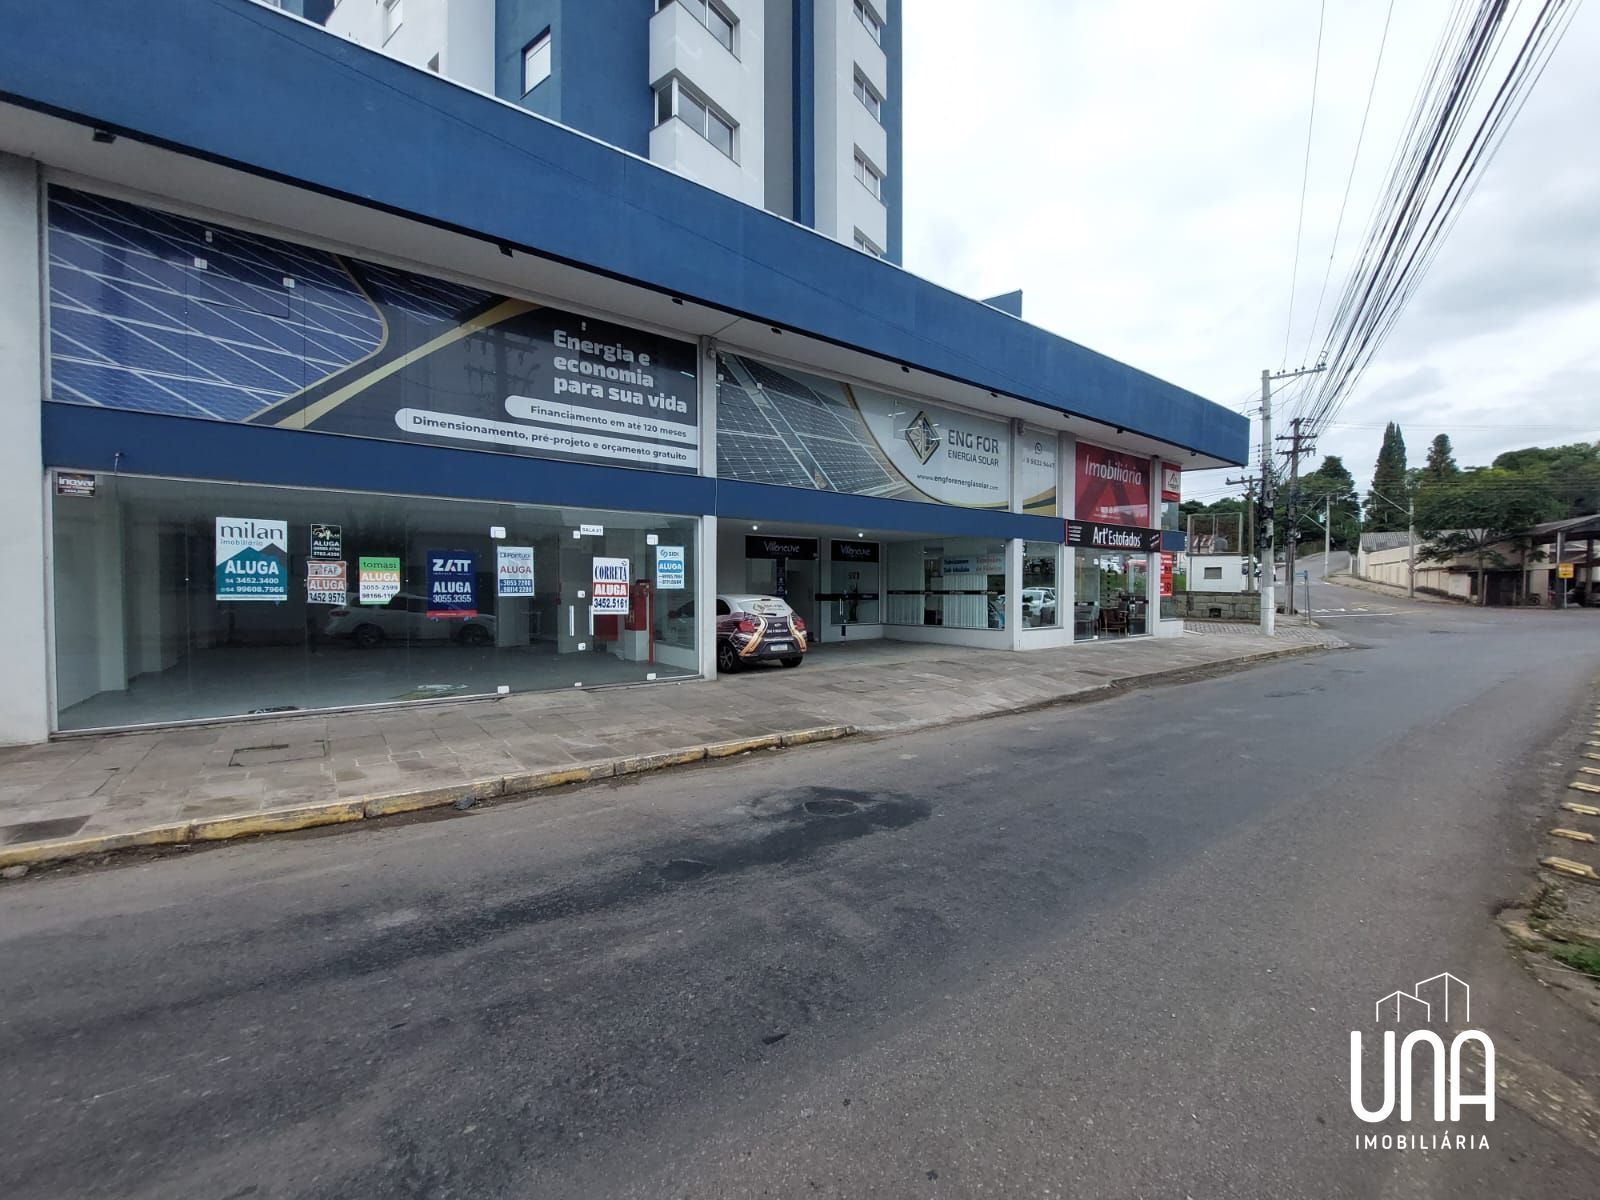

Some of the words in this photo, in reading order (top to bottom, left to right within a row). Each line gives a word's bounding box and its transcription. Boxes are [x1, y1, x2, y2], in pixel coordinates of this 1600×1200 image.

[553, 329, 635, 363] Energia
[638, 353, 651, 366] e
[553, 356, 654, 388] economia
[553, 377, 604, 399] para
[608, 387, 644, 405] sua
[648, 393, 688, 413] vida
[530, 405, 607, 425] Financiamento
[610, 419, 625, 428] em
[627, 420, 642, 431] até
[643, 423, 658, 433] 120
[660, 428, 687, 438] meses
[413, 415, 529, 440] Dimensionamento,
[531, 431, 591, 449] pré-projeto
[601, 443, 651, 456] orçamento
[652, 449, 687, 461] gratuito
[948, 429, 973, 449] ENG
[976, 435, 999, 454] FOR
[948, 449, 977, 463] ENERGIA
[978, 456, 999, 467] SOLAR
[1085, 454, 1142, 485] Imobiliária
[59, 476, 94, 487] inovar
[917, 474, 999, 491] www.engforenergiasolar.com
[220, 521, 283, 540] milan
[224, 560, 279, 575] ALUGA
[323, 564, 338, 573] FAF
[363, 561, 397, 569] tomasi
[432, 559, 472, 572] ZATT
[500, 565, 532, 574] ALUGA
[659, 562, 682, 570] ALUGA
[361, 572, 398, 581] ALUGA
[594, 565, 627, 581] CORRETA
[309, 580, 345, 590] ALUGA
[433, 581, 472, 593] ALUGA
[594, 583, 627, 595] ALUGA
[309, 592, 327, 602] 3452
[328, 593, 345, 602] 9575
[432, 594, 472, 603] 3055.3355
[593, 598, 628, 609] 3452.5161
